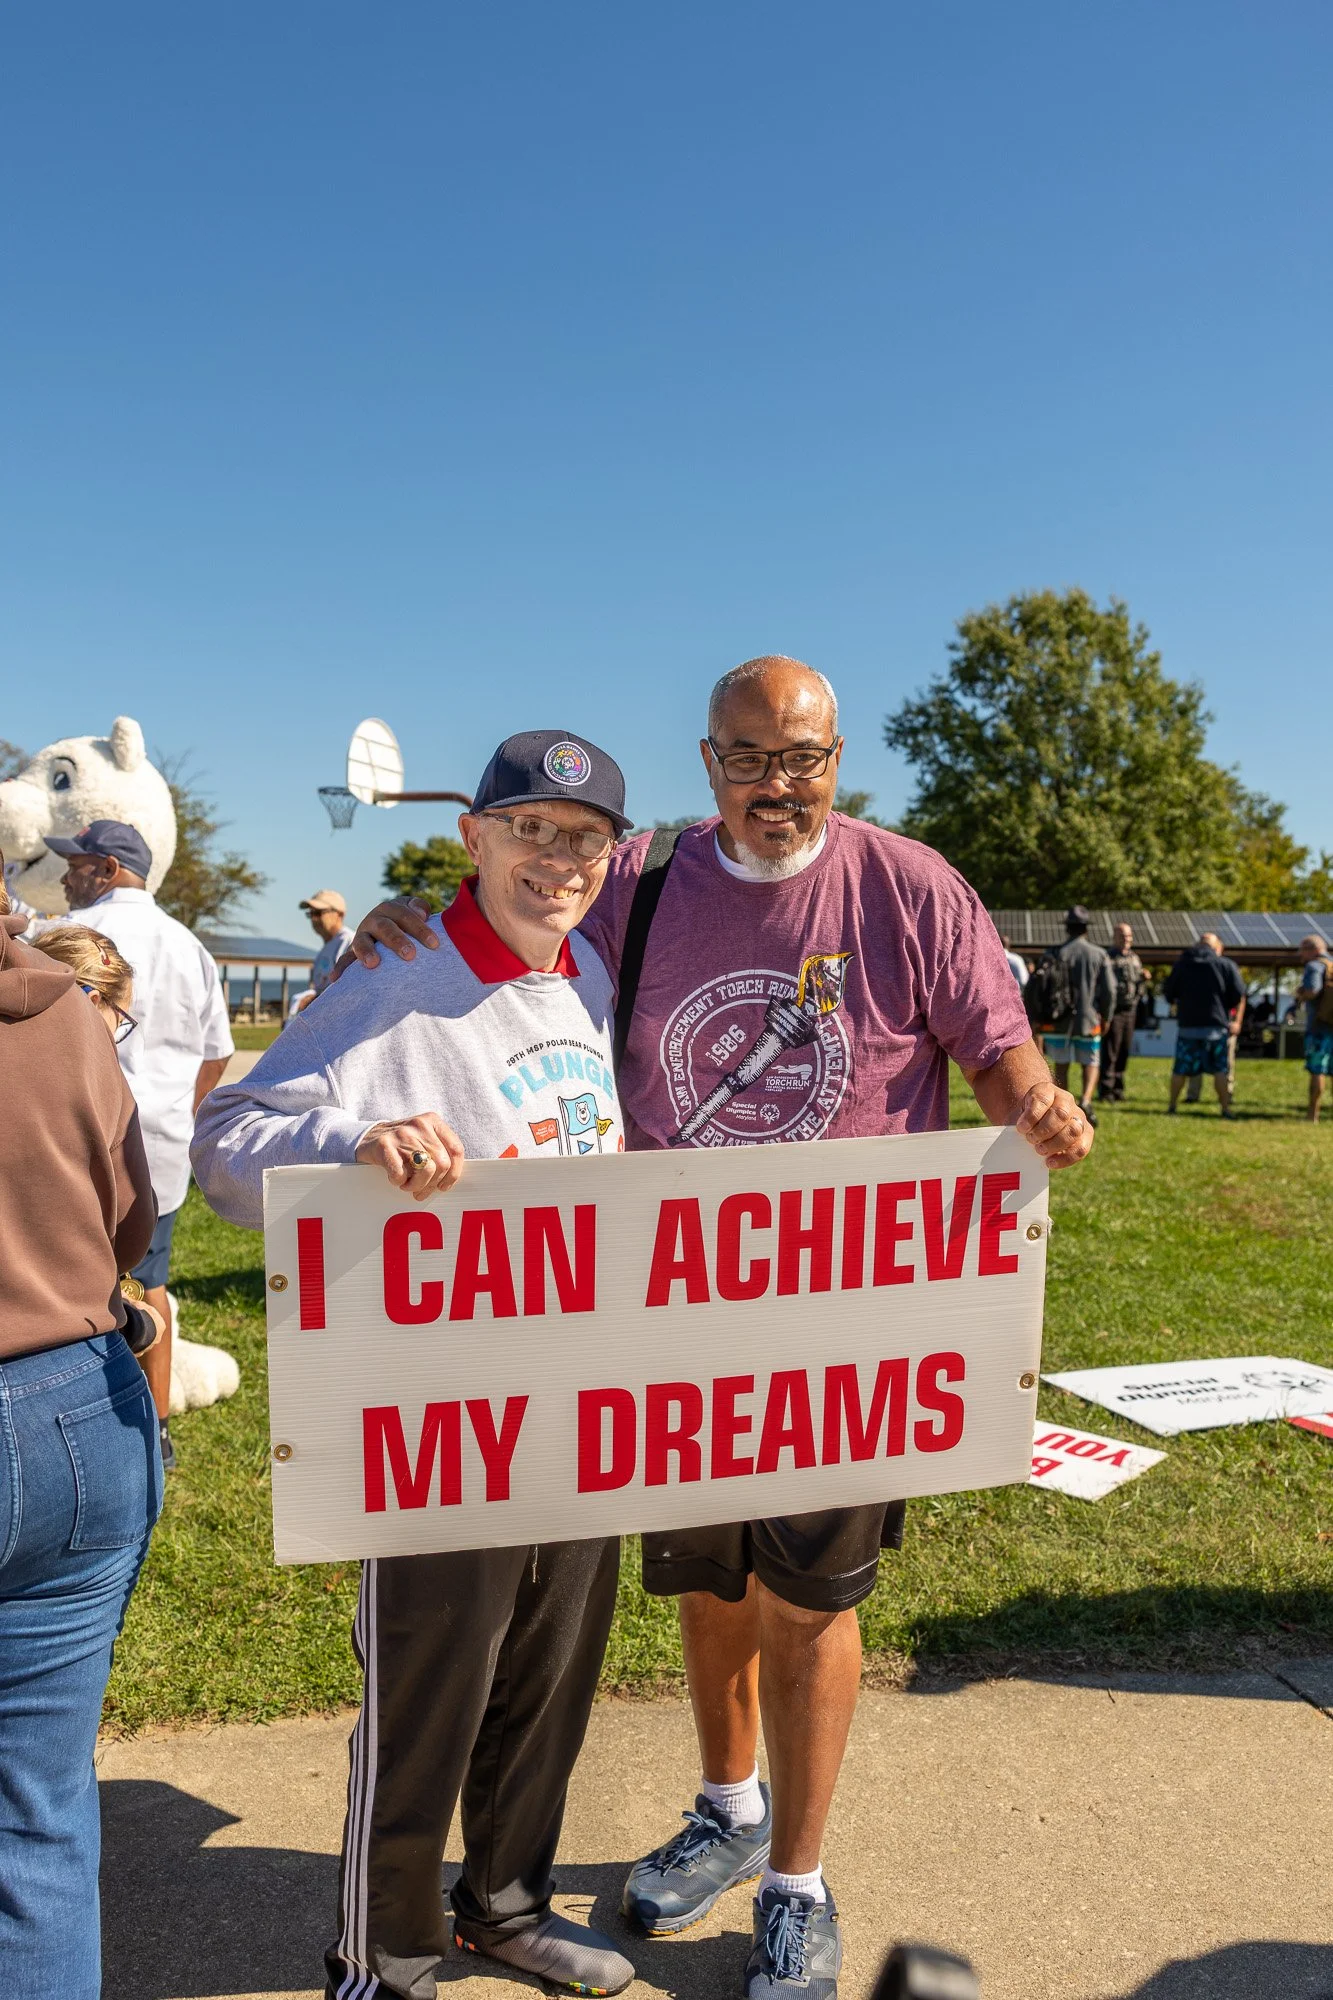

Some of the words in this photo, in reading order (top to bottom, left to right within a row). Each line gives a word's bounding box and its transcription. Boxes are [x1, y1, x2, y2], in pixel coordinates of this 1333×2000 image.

[716, 979, 765, 999] TORCH
[768, 982, 800, 999] RUN
[526, 1042, 544, 1055] MSP
[546, 1038, 568, 1048] POLAR
[568, 1039, 582, 1048] BEAR
[583, 1043, 605, 1062] PLUNGE
[668, 992, 714, 1083] ENFORCEMENT
[705, 1023, 747, 1068] 1986
[499, 1050, 614, 1108] PLUNGE
[699, 1124, 757, 1147] BRA
[785, 1111, 824, 1142] THE
[815, 1018, 843, 1112] ATTEMPT
[675, 1085, 692, 1116] LAW
[725, 1107, 757, 1115] Olympics
[731, 1101, 757, 1109] Special
[297, 1217, 326, 1331] I
[383, 1205, 596, 1325] CAN
[645, 1171, 1021, 1307] ACHIEVE
[1116, 1386, 1240, 1402] Olympics
[1123, 1377, 1219, 1391] Special
[362, 1395, 530, 1513] MY
[577, 1351, 966, 1494] DREAMS
[1034, 1432, 1132, 1467] YOU
